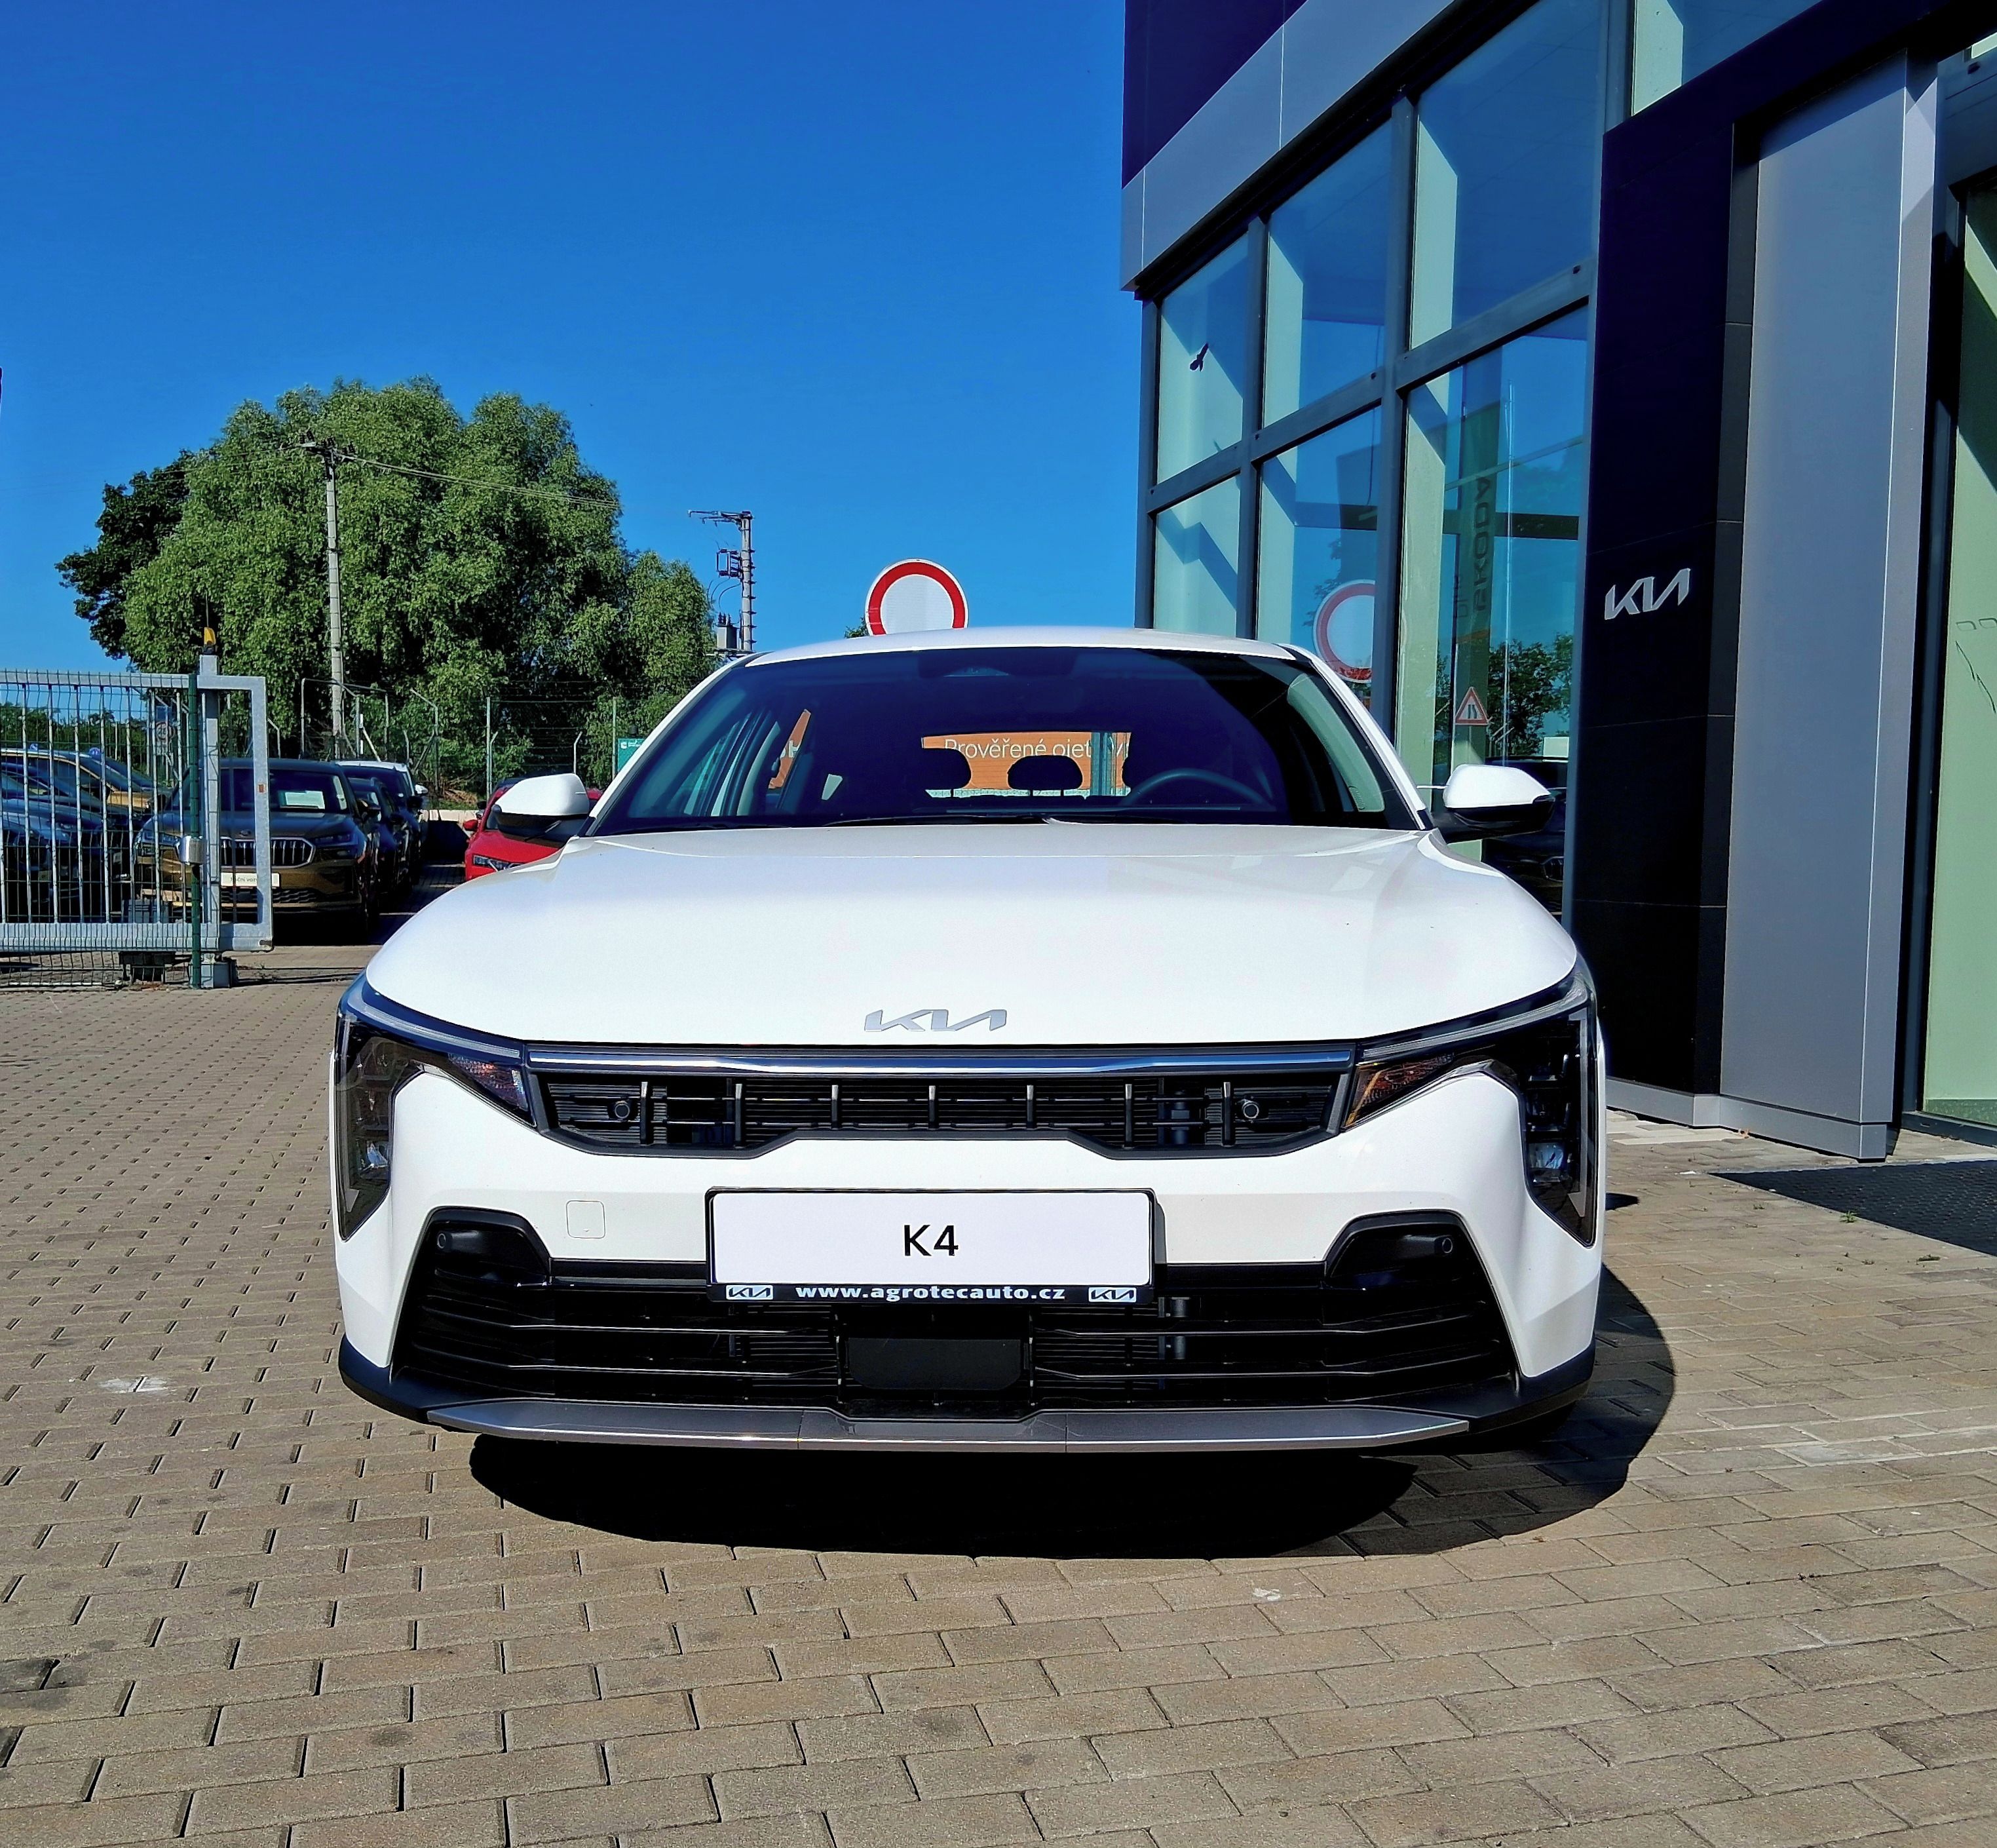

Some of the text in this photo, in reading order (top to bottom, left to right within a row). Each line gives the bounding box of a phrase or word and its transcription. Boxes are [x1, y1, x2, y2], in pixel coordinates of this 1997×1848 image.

[1605, 568, 1691, 620] KIA
[864, 1009, 1007, 1031] KIA
[903, 1224, 959, 1257] K4
[728, 1286, 1134, 1302] KIA www.agrotecauto.cz KIA
